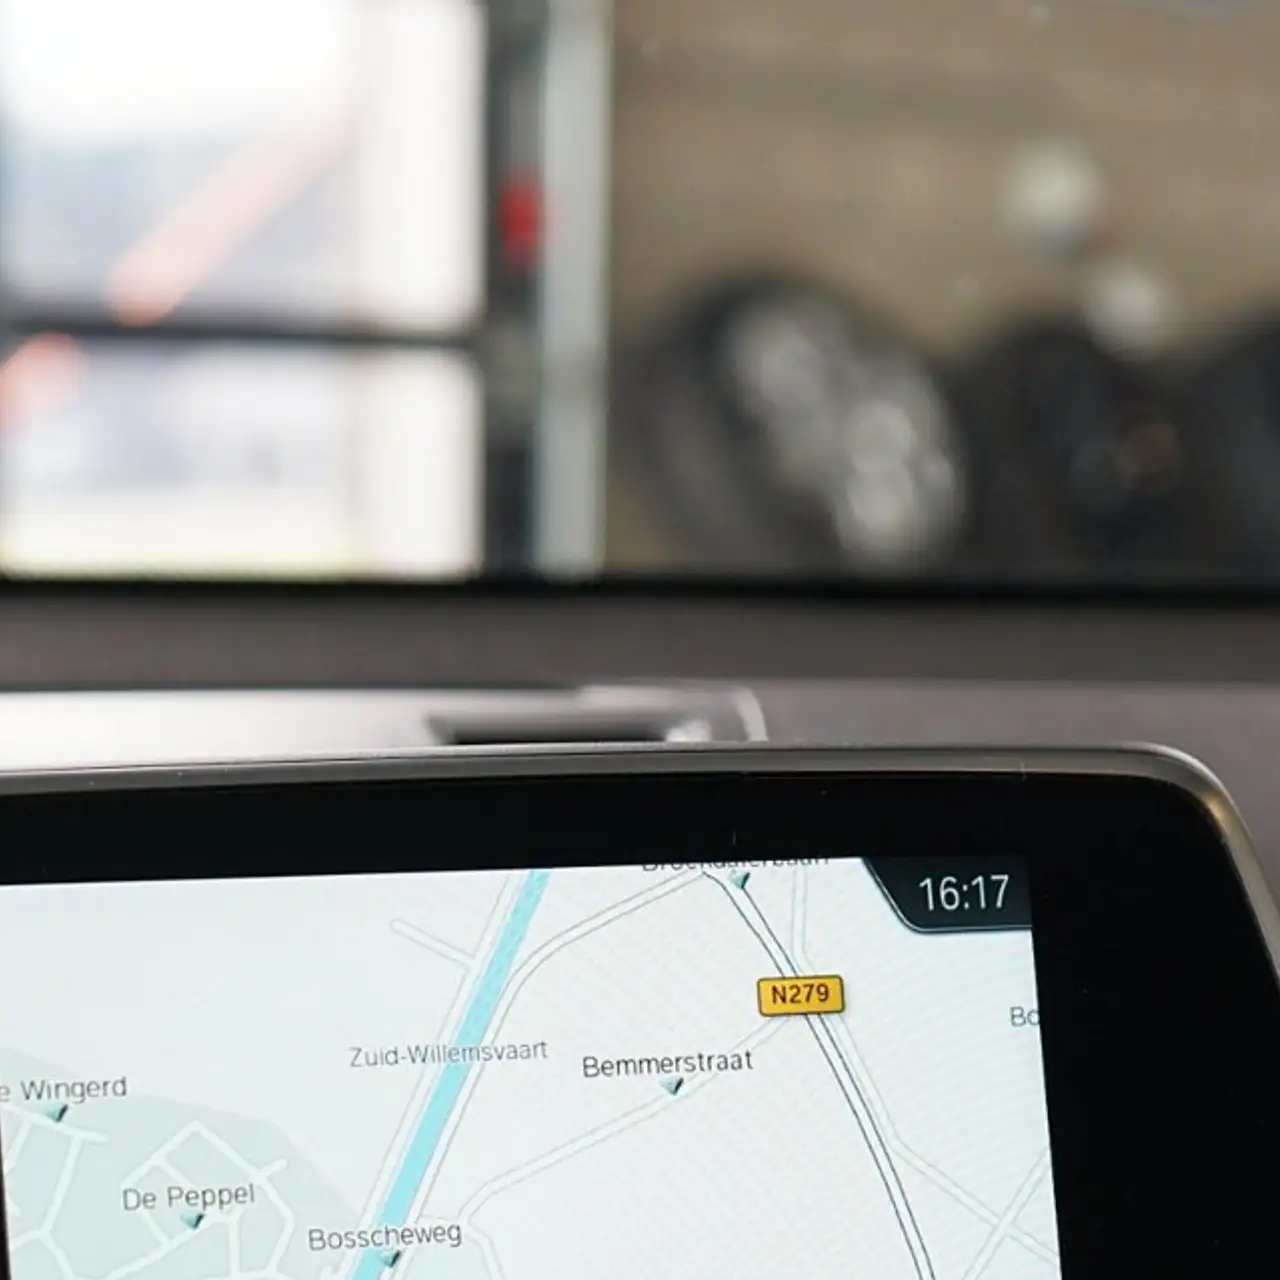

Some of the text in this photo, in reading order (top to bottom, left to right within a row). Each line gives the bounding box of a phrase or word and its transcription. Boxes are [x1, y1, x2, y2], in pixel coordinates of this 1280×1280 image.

[918, 874, 1011, 912] 16:17
[770, 982, 830, 1007] N279
[349, 1041, 549, 1068] Zuid-Willemsvaart
[582, 1050, 754, 1078] Bemmerstraat
[20, 1076, 127, 1105] Wingerd
[122, 1182, 255, 1211] De Peppel
[308, 1222, 462, 1253] Bosscheweg
